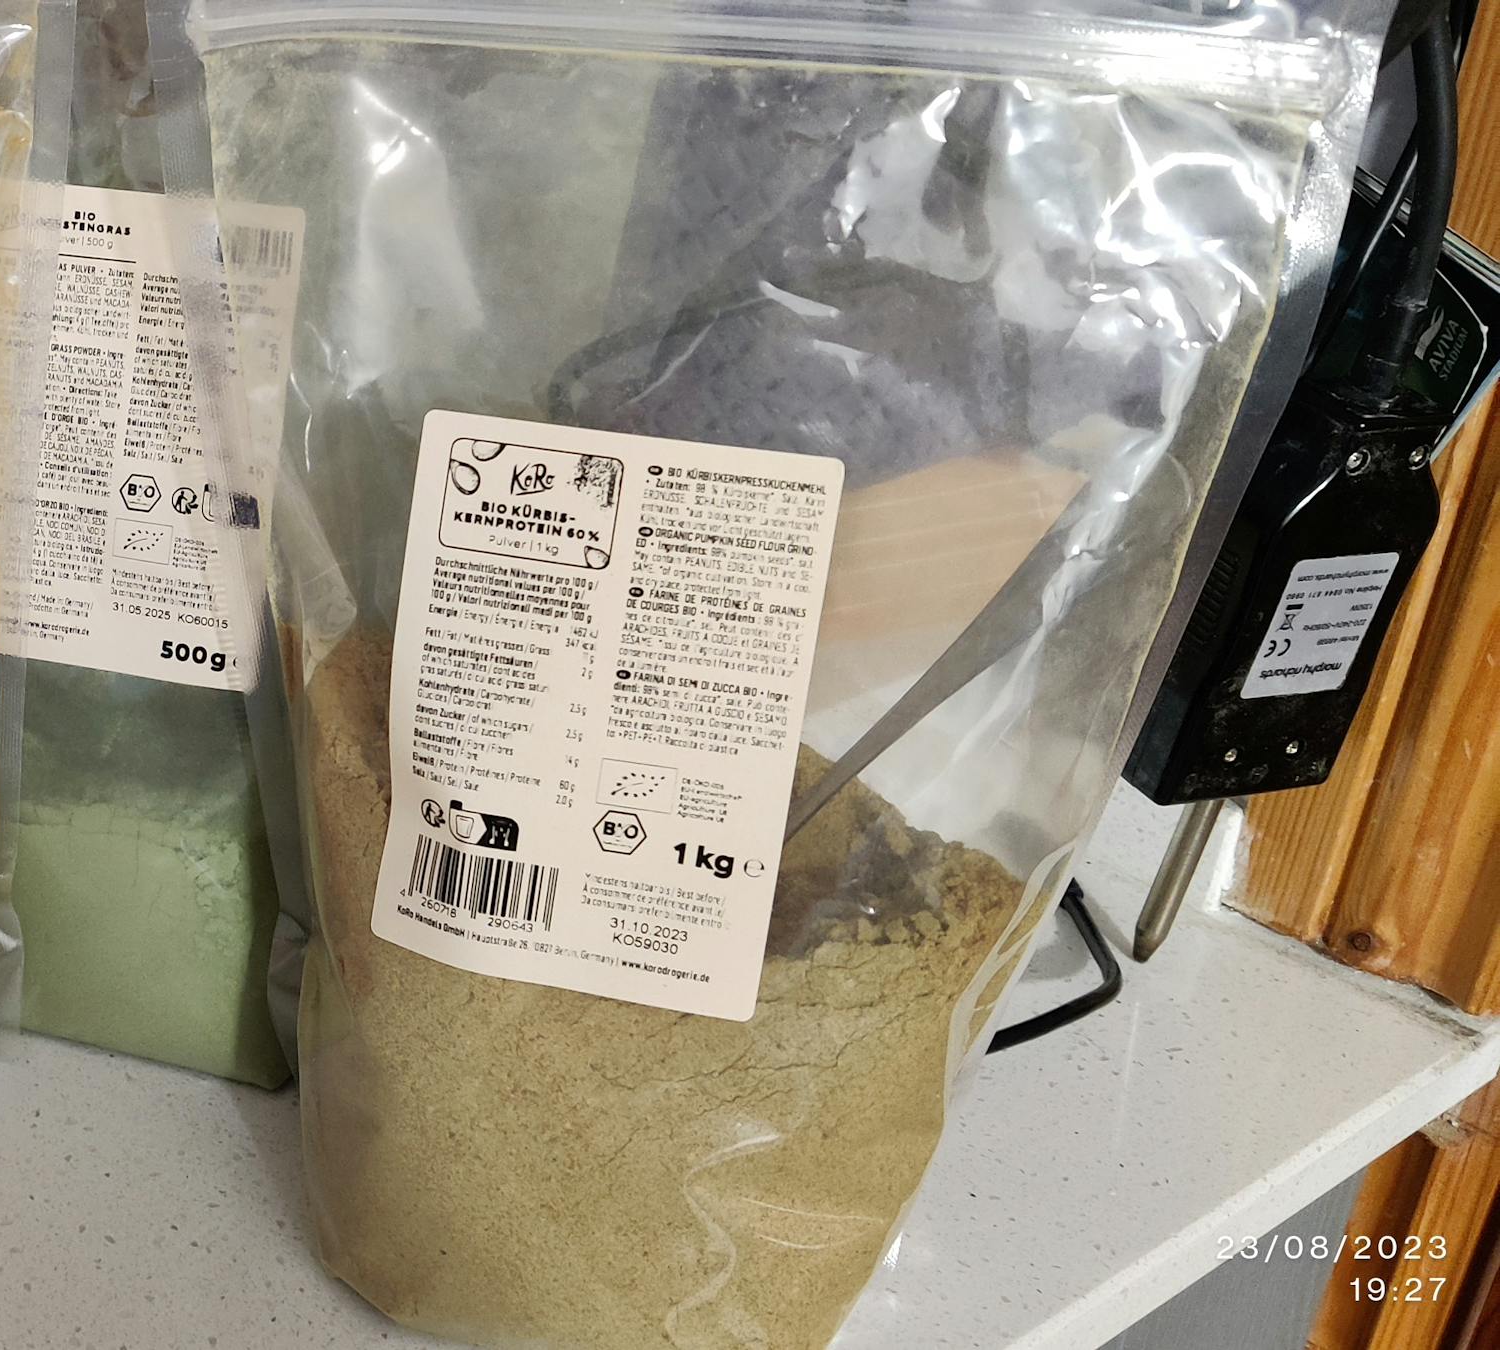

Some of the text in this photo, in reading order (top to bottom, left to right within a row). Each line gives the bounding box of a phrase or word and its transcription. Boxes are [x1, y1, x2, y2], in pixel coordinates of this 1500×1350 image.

[74, 211, 95, 220] BIO
[87, 237, 113, 250] 500 g
[1429, 320, 1459, 372] AVIVA
[1439, 328, 1468, 380] STADIUM
[510, 463, 555, 495] KoRo
[481, 501, 576, 523] BIO KÜRBIS-
[454, 511, 599, 542] KERNPROTEIN 60 %
[736, 537, 756, 549] SEED
[177, 614, 228, 628] KO60015
[160, 640, 226, 672] 500 g
[1302, 662, 1342, 675] morphy
[673, 843, 735, 879] 1 kg
[420, 896, 534, 933] 260718 290643
[610, 918, 689, 942] 31.10.2023
[612, 933, 679, 955] KO59030
